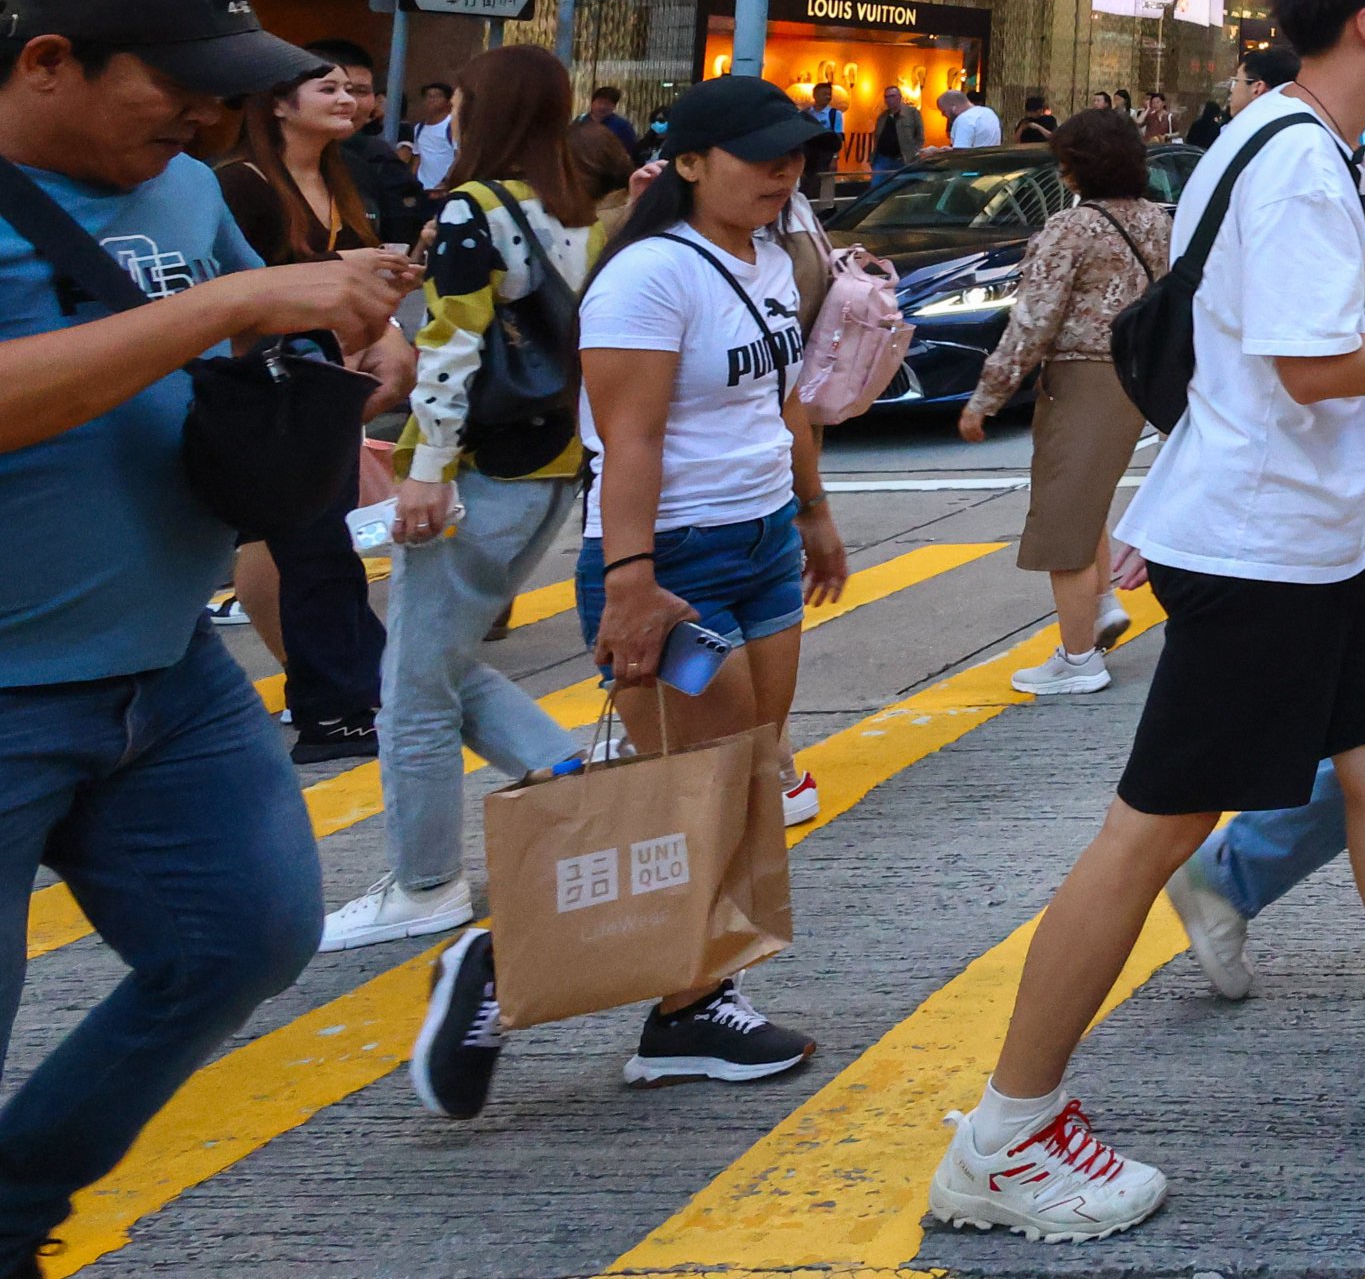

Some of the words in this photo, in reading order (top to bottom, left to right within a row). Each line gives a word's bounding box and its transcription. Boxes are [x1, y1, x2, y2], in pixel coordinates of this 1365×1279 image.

[857, 2, 917, 26] VUITTON
[638, 841, 678, 864] UNI
[566, 856, 609, 882] ユニ
[639, 861, 682, 887] QLO
[566, 878, 609, 905] クロ
